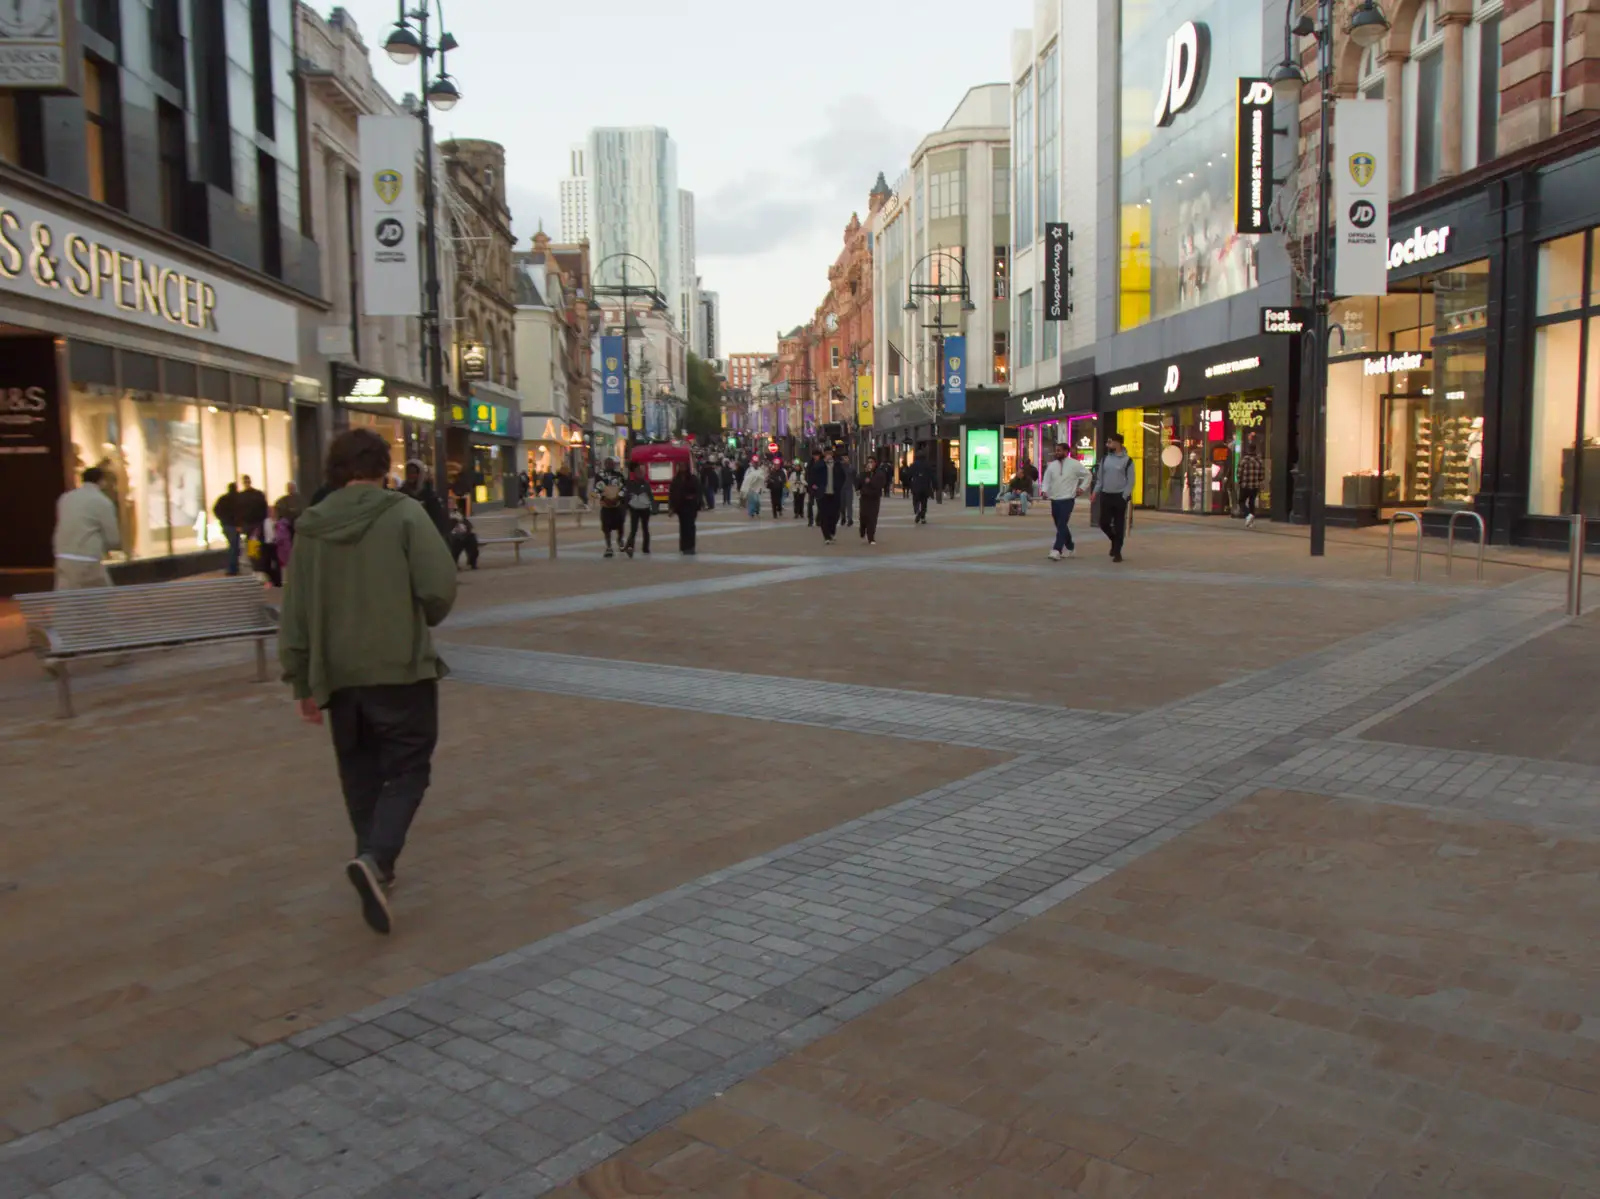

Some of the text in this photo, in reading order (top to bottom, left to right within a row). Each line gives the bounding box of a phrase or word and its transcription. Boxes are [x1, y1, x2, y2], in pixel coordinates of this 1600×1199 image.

[1154, 20, 1205, 127] JD
[1243, 82, 1272, 104] JD
[1352, 206, 1374, 222] JD
[30, 221, 60, 289] &
[64, 232, 218, 333] SPENCER
[1051, 242, 1063, 317] Superdrug
[1164, 365, 1179, 393] JD
[1022, 394, 1056, 415] Superdrug
